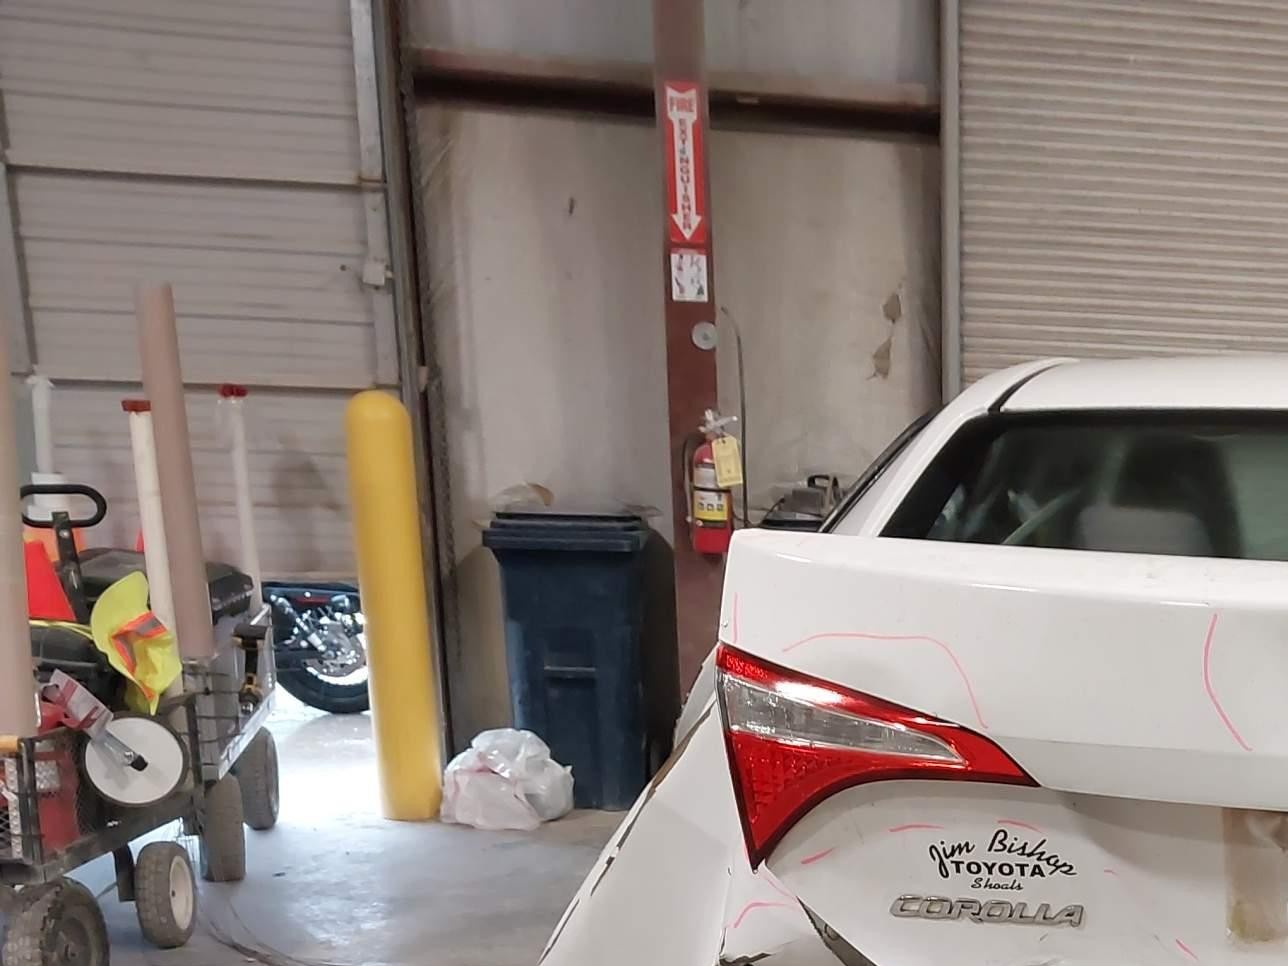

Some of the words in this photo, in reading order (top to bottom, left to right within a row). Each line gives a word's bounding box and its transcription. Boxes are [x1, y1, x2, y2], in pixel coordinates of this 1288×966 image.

[669, 96, 694, 113] FIRE
[679, 118, 692, 230] EXTINGUISHER
[929, 840, 975, 879] Jim
[987, 829, 1077, 876] Bishop
[950, 860, 1045, 878] TOYOTA
[971, 877, 1024, 891] Shoals
[889, 894, 1085, 928] COROLLA
